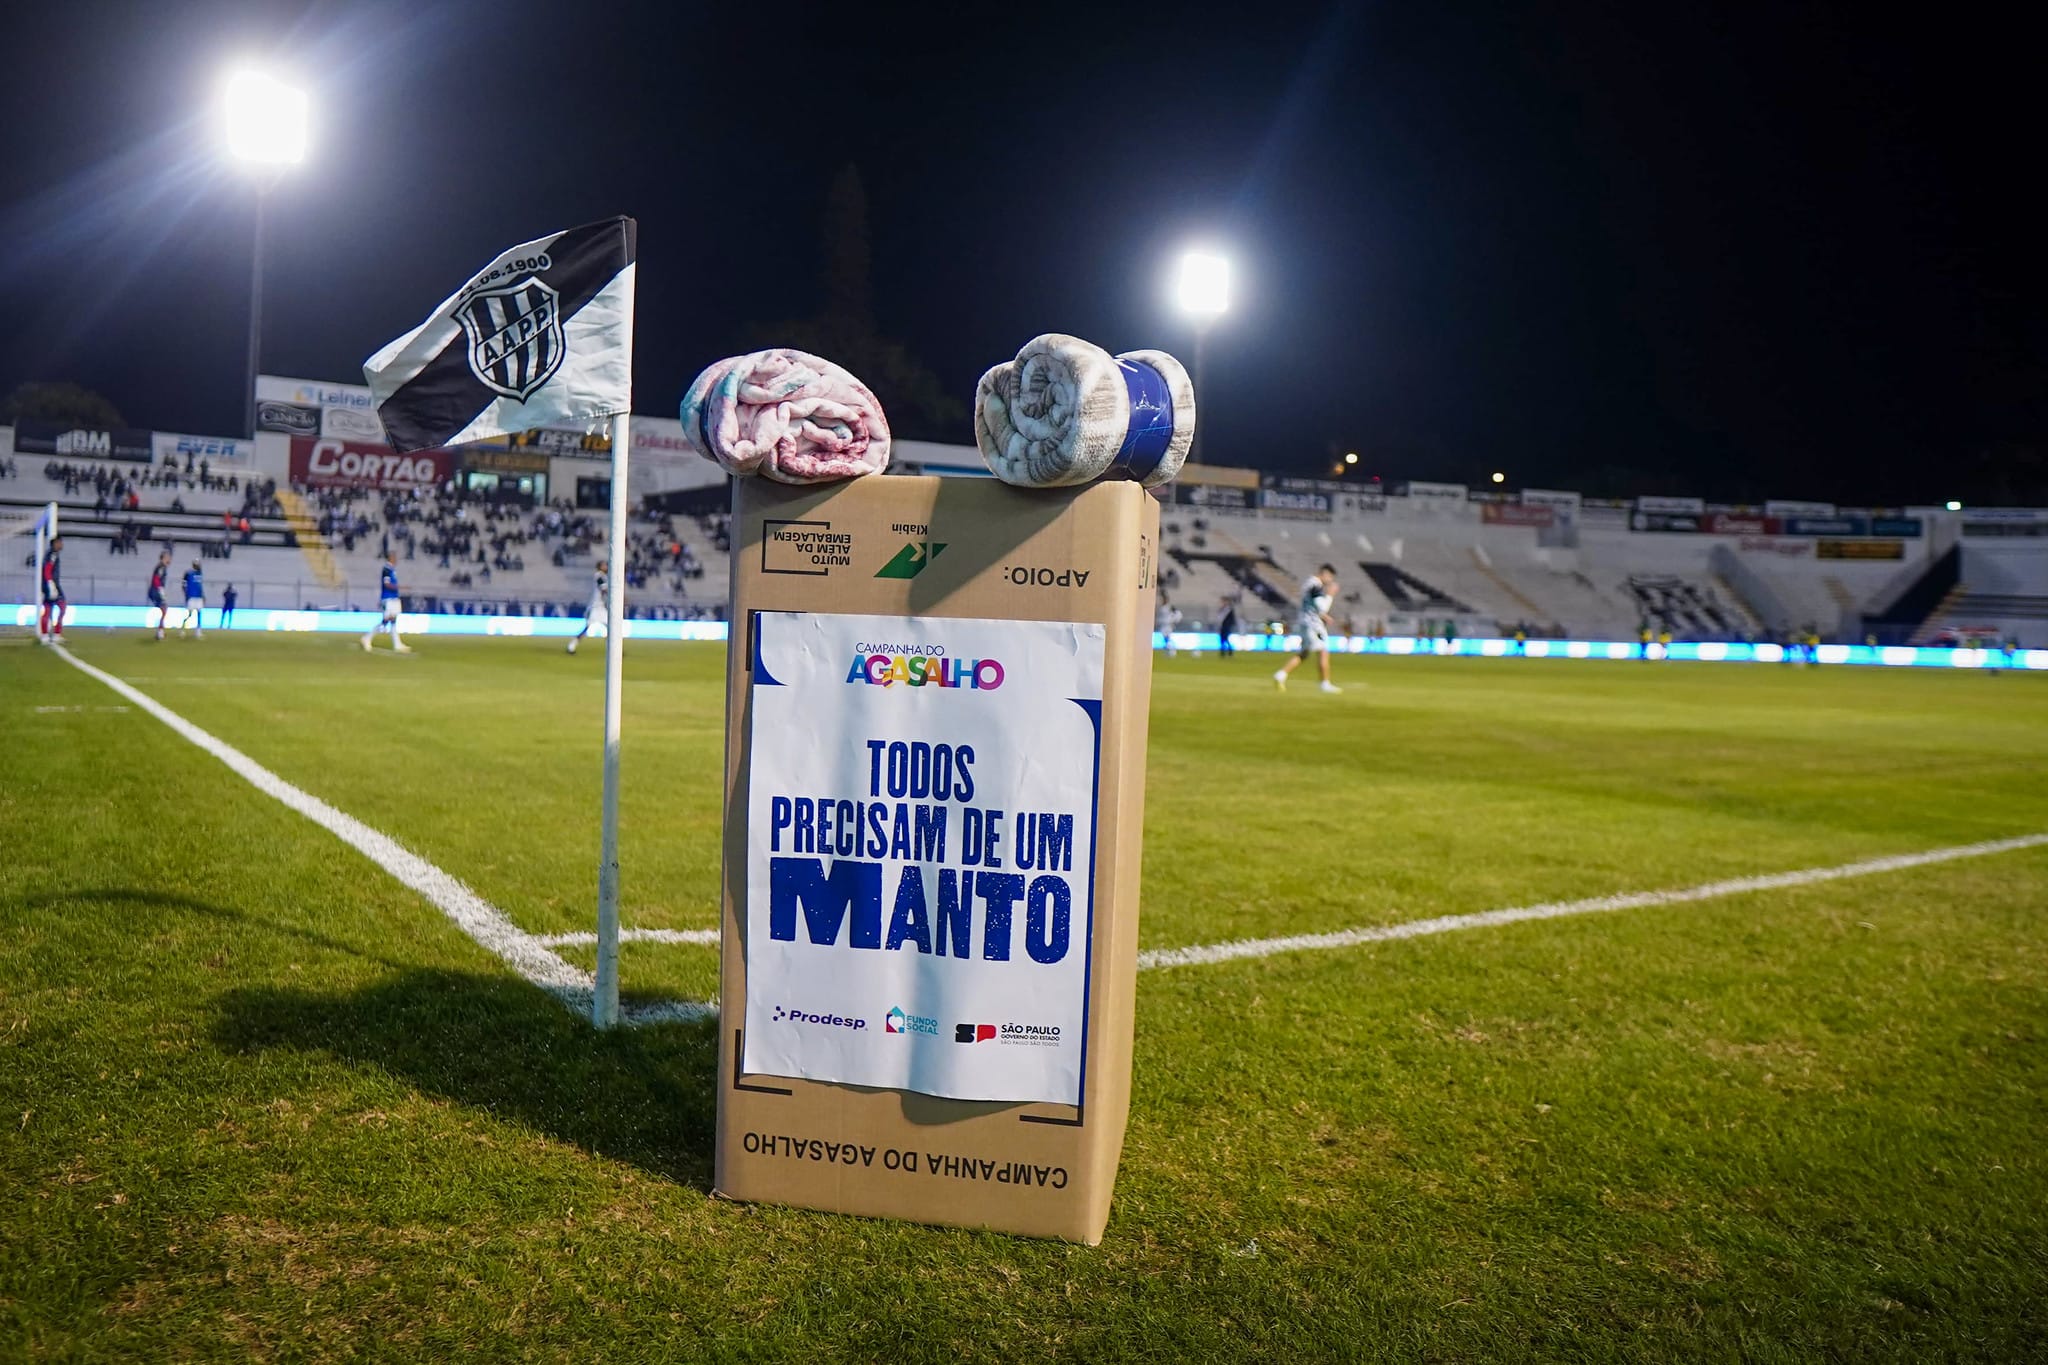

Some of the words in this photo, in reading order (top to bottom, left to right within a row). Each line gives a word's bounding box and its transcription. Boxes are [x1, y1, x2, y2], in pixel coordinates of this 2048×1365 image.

[308, 439, 436, 482] CORTAG
[774, 531, 851, 544] EMBALAGEM
[892, 523, 928, 535] Klabin
[796, 543, 813, 553] DA
[817, 544, 851, 556] ALÉM
[811, 554, 850, 566] MUITO
[1004, 567, 1090, 588] APOIO:
[855, 642, 923, 655] CAMPANHA
[926, 645, 945, 656] DO
[846, 655, 1005, 690] AGASALHO
[867, 740, 975, 802] TODOS
[771, 796, 948, 863] PRECISAM
[962, 807, 1003, 868] DE
[1015, 812, 1073, 871] UM
[770, 857, 1072, 964] MANTO
[789, 1010, 866, 1031] Prodesp
[906, 1015, 938, 1027] FUNDO
[906, 1023, 939, 1035] SOCIAL
[1001, 1023, 1023, 1034] SÃO
[1025, 1025, 1061, 1035] PAULO
[744, 1132, 876, 1167] AGASALHO
[884, 1149, 918, 1173] DO
[927, 1152, 1069, 1189] CAMPANHA
